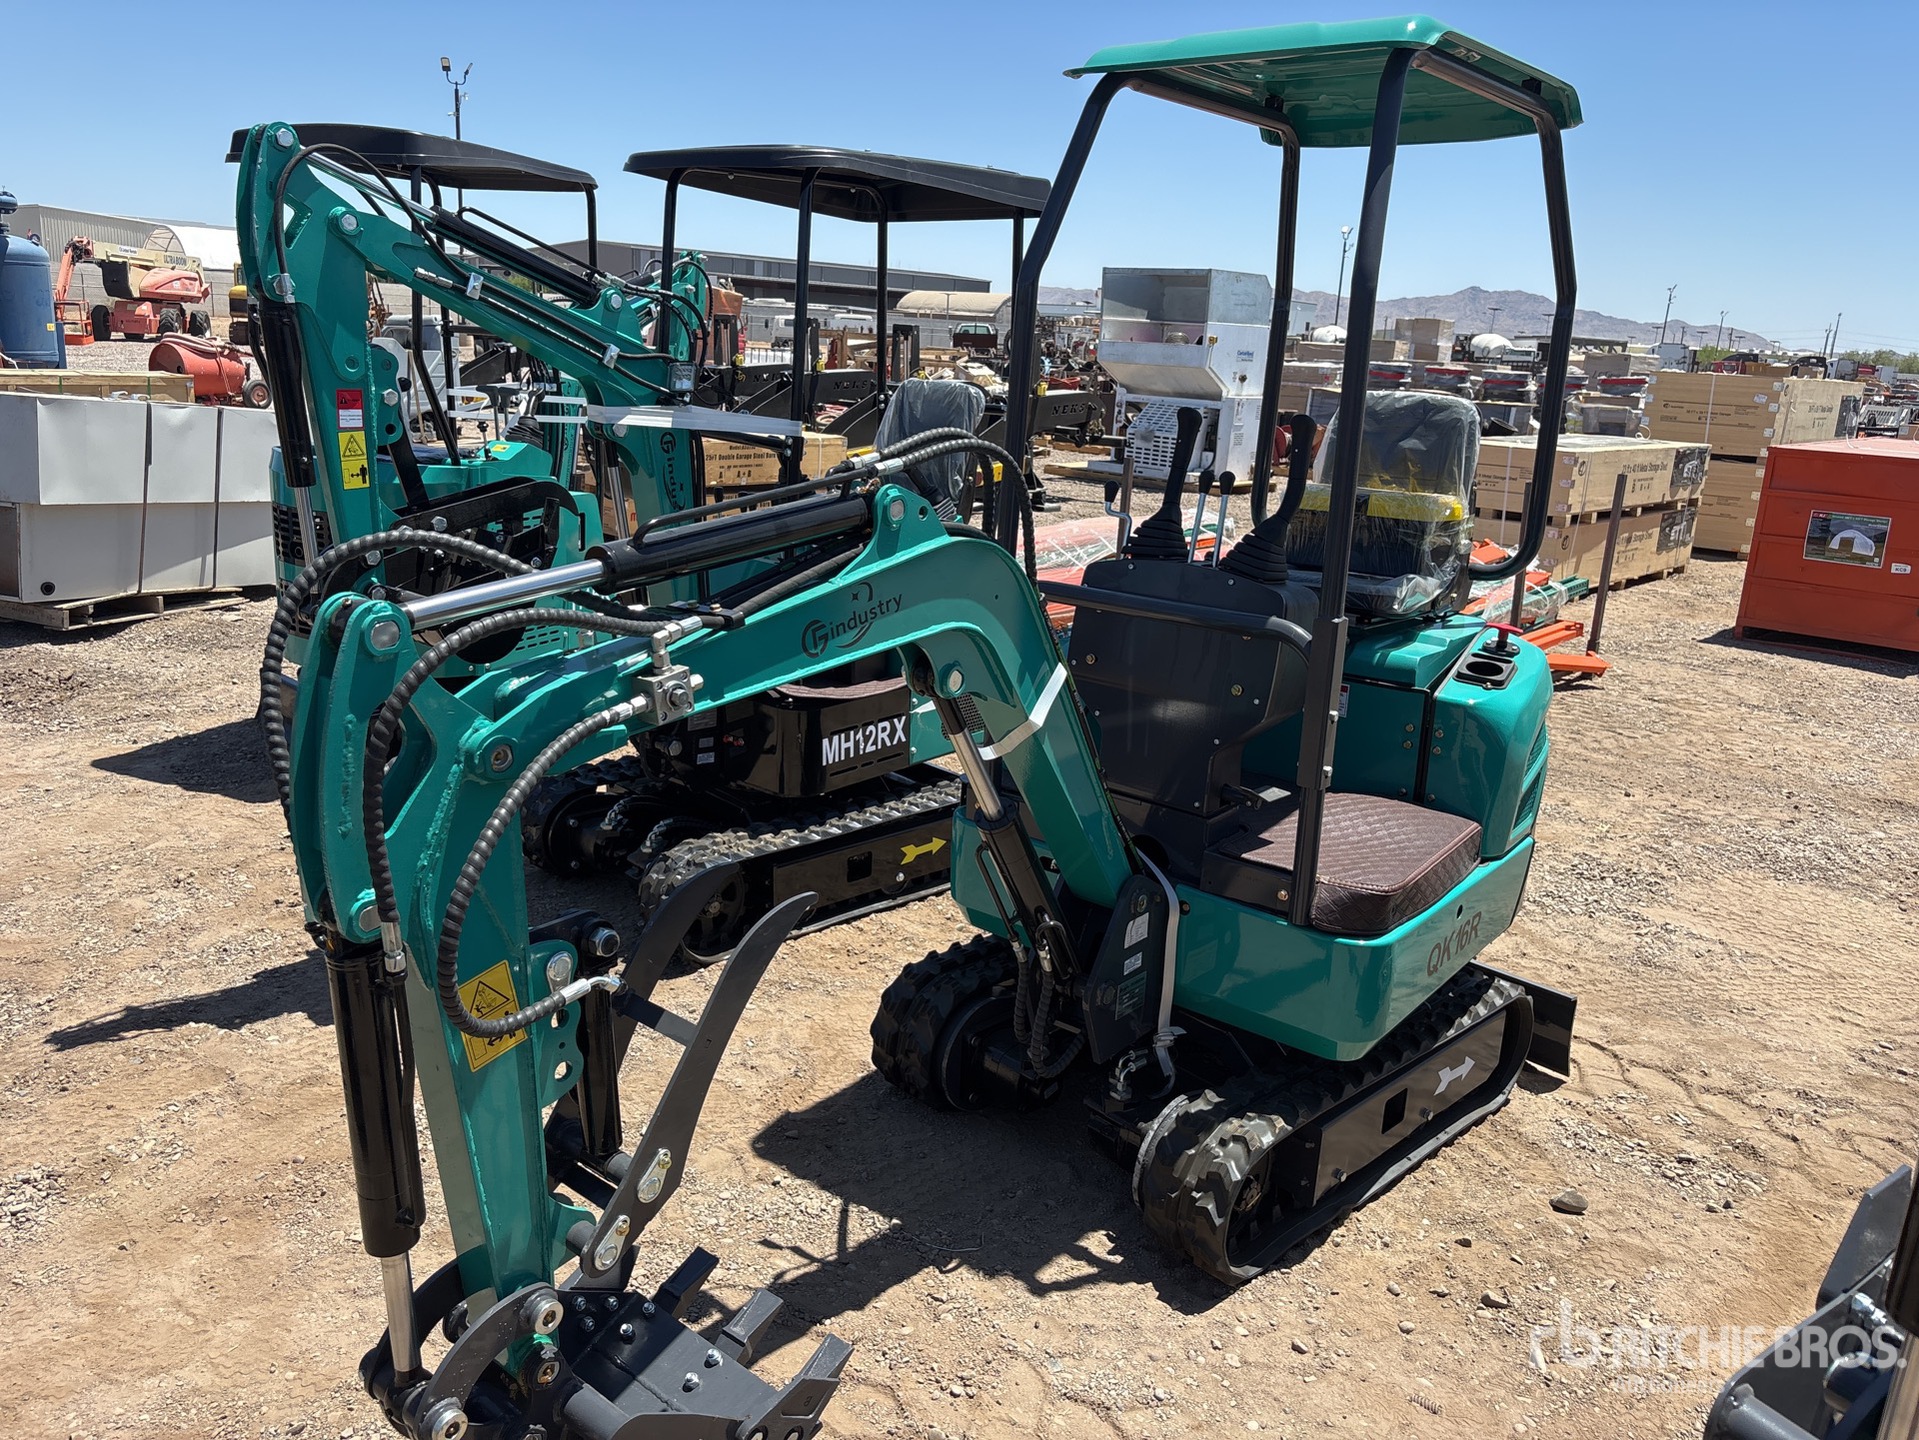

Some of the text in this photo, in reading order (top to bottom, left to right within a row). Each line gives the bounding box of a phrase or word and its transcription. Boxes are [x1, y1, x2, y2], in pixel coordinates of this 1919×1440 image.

[1051, 403, 1086, 416] NEKS
[718, 453, 735, 461] Double
[822, 716, 907, 767] MH12RX
